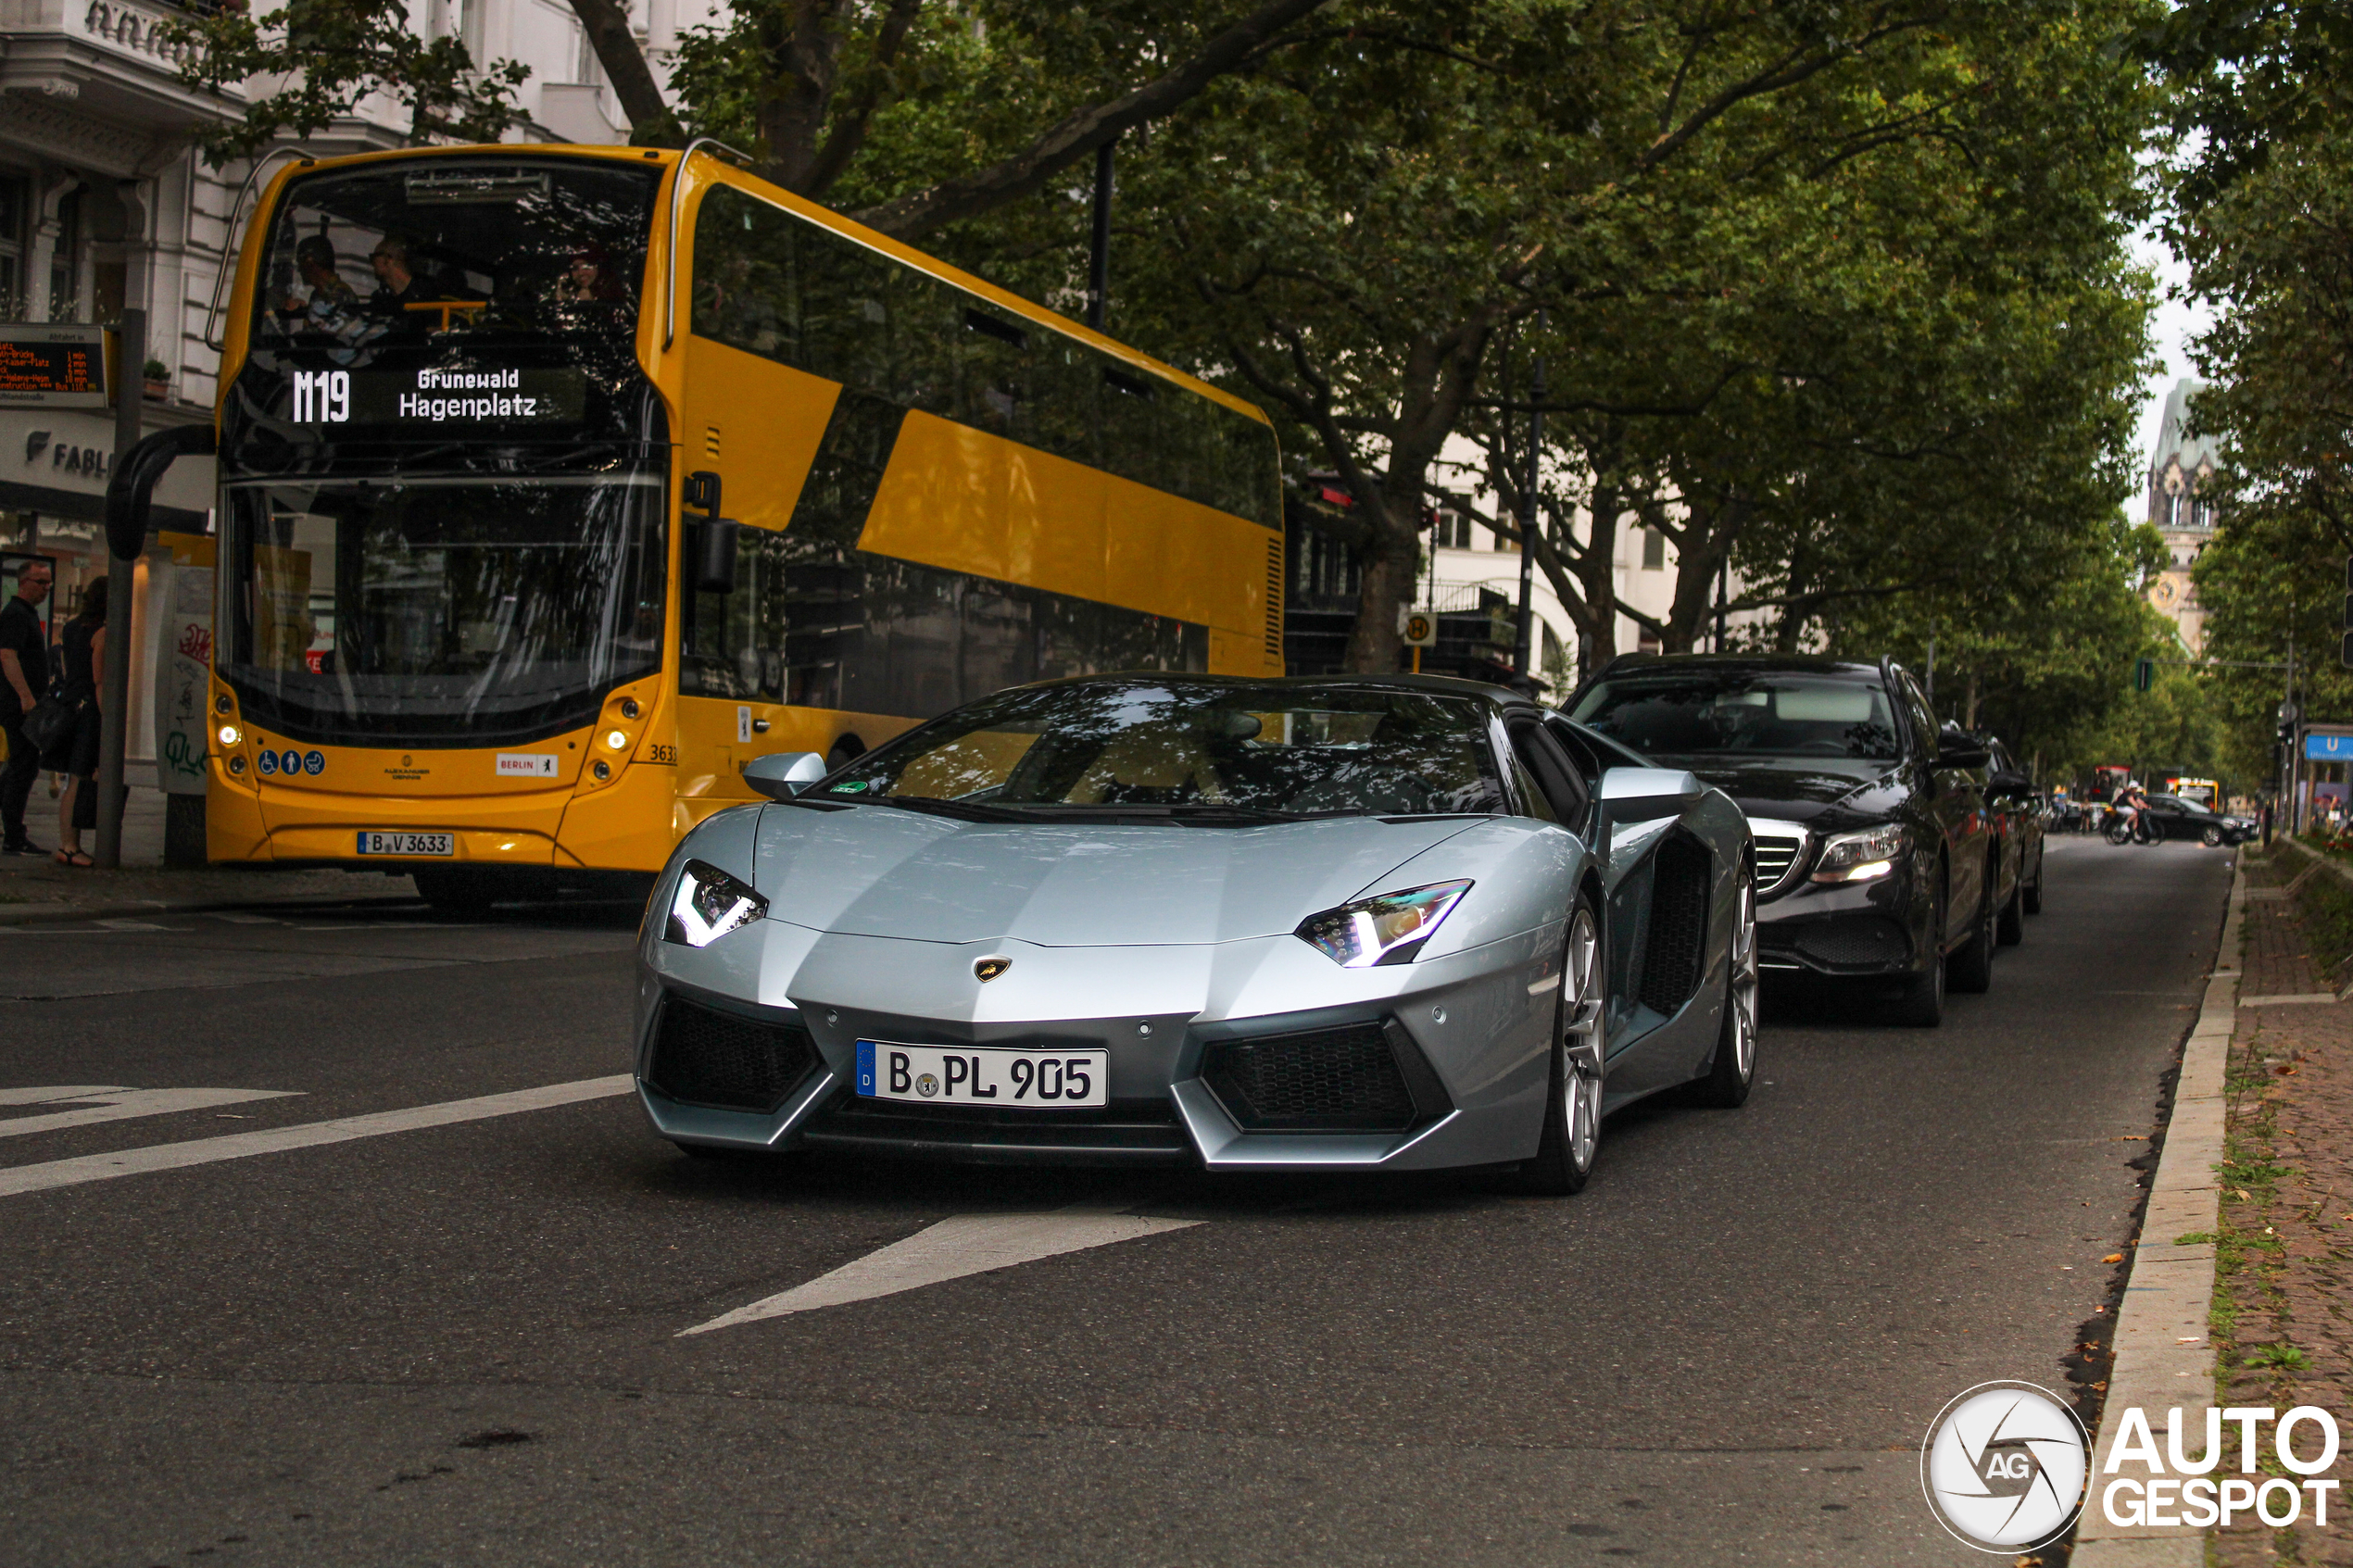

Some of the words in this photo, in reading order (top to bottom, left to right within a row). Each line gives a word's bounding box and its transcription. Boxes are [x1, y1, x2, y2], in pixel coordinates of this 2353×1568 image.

[72, 351, 86, 359] min
[73, 359, 86, 368] min
[74, 375, 87, 383] min
[418, 369, 519, 389] Grunewald
[294, 370, 350, 423] M19
[400, 392, 536, 421] Hagenplatz
[2327, 737, 2338, 751] U
[501, 760, 534, 770] BERLIN
[372, 834, 384, 851] B
[393, 835, 404, 851] V
[407, 835, 447, 852] 3633
[890, 1051, 912, 1094] B
[943, 1055, 998, 1098] PL
[1011, 1058, 1092, 1100] 905
